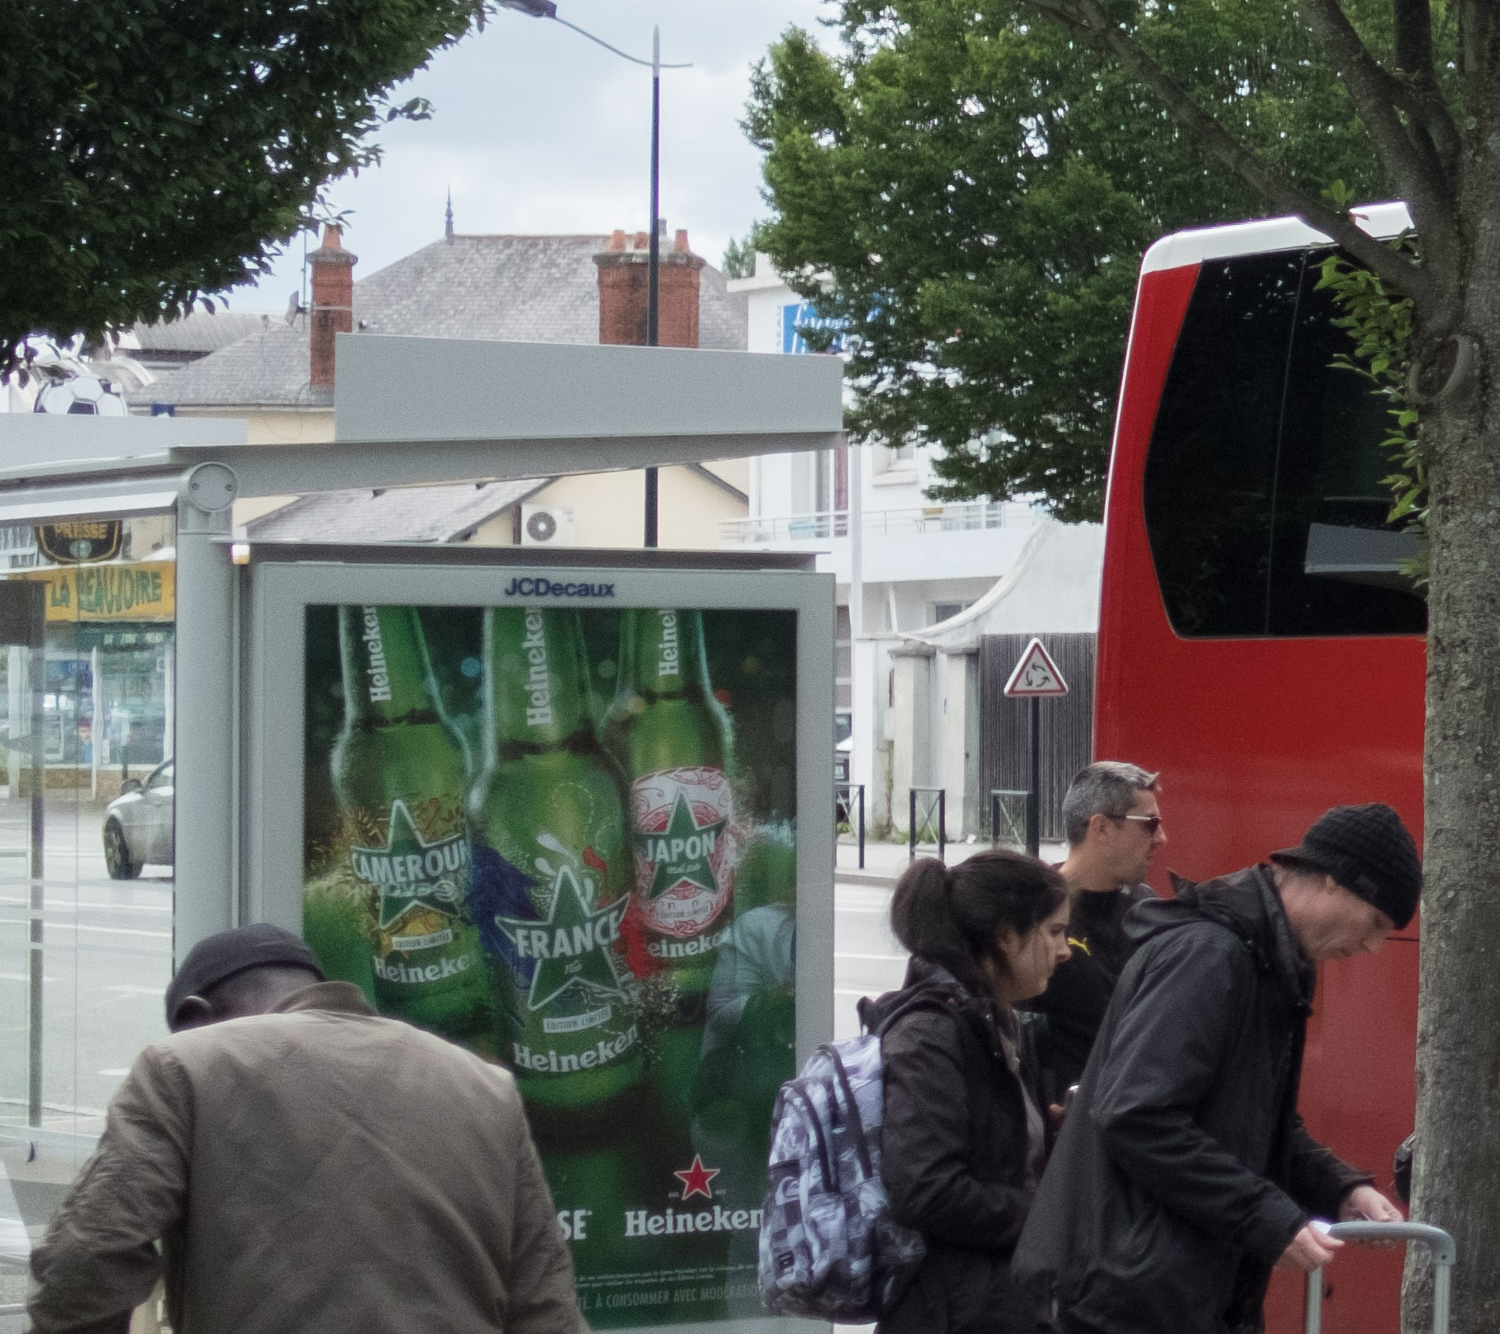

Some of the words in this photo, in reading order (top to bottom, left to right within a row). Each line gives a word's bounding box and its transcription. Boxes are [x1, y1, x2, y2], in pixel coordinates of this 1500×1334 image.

[504, 577, 616, 598] JCDecaux
[646, 830, 716, 863] JAPON
[515, 910, 621, 959] FRANCE
[513, 1024, 639, 1073] Heineken
[606, 1289, 670, 1309] CONSOMMER
[673, 1287, 698, 1304] AVEC
